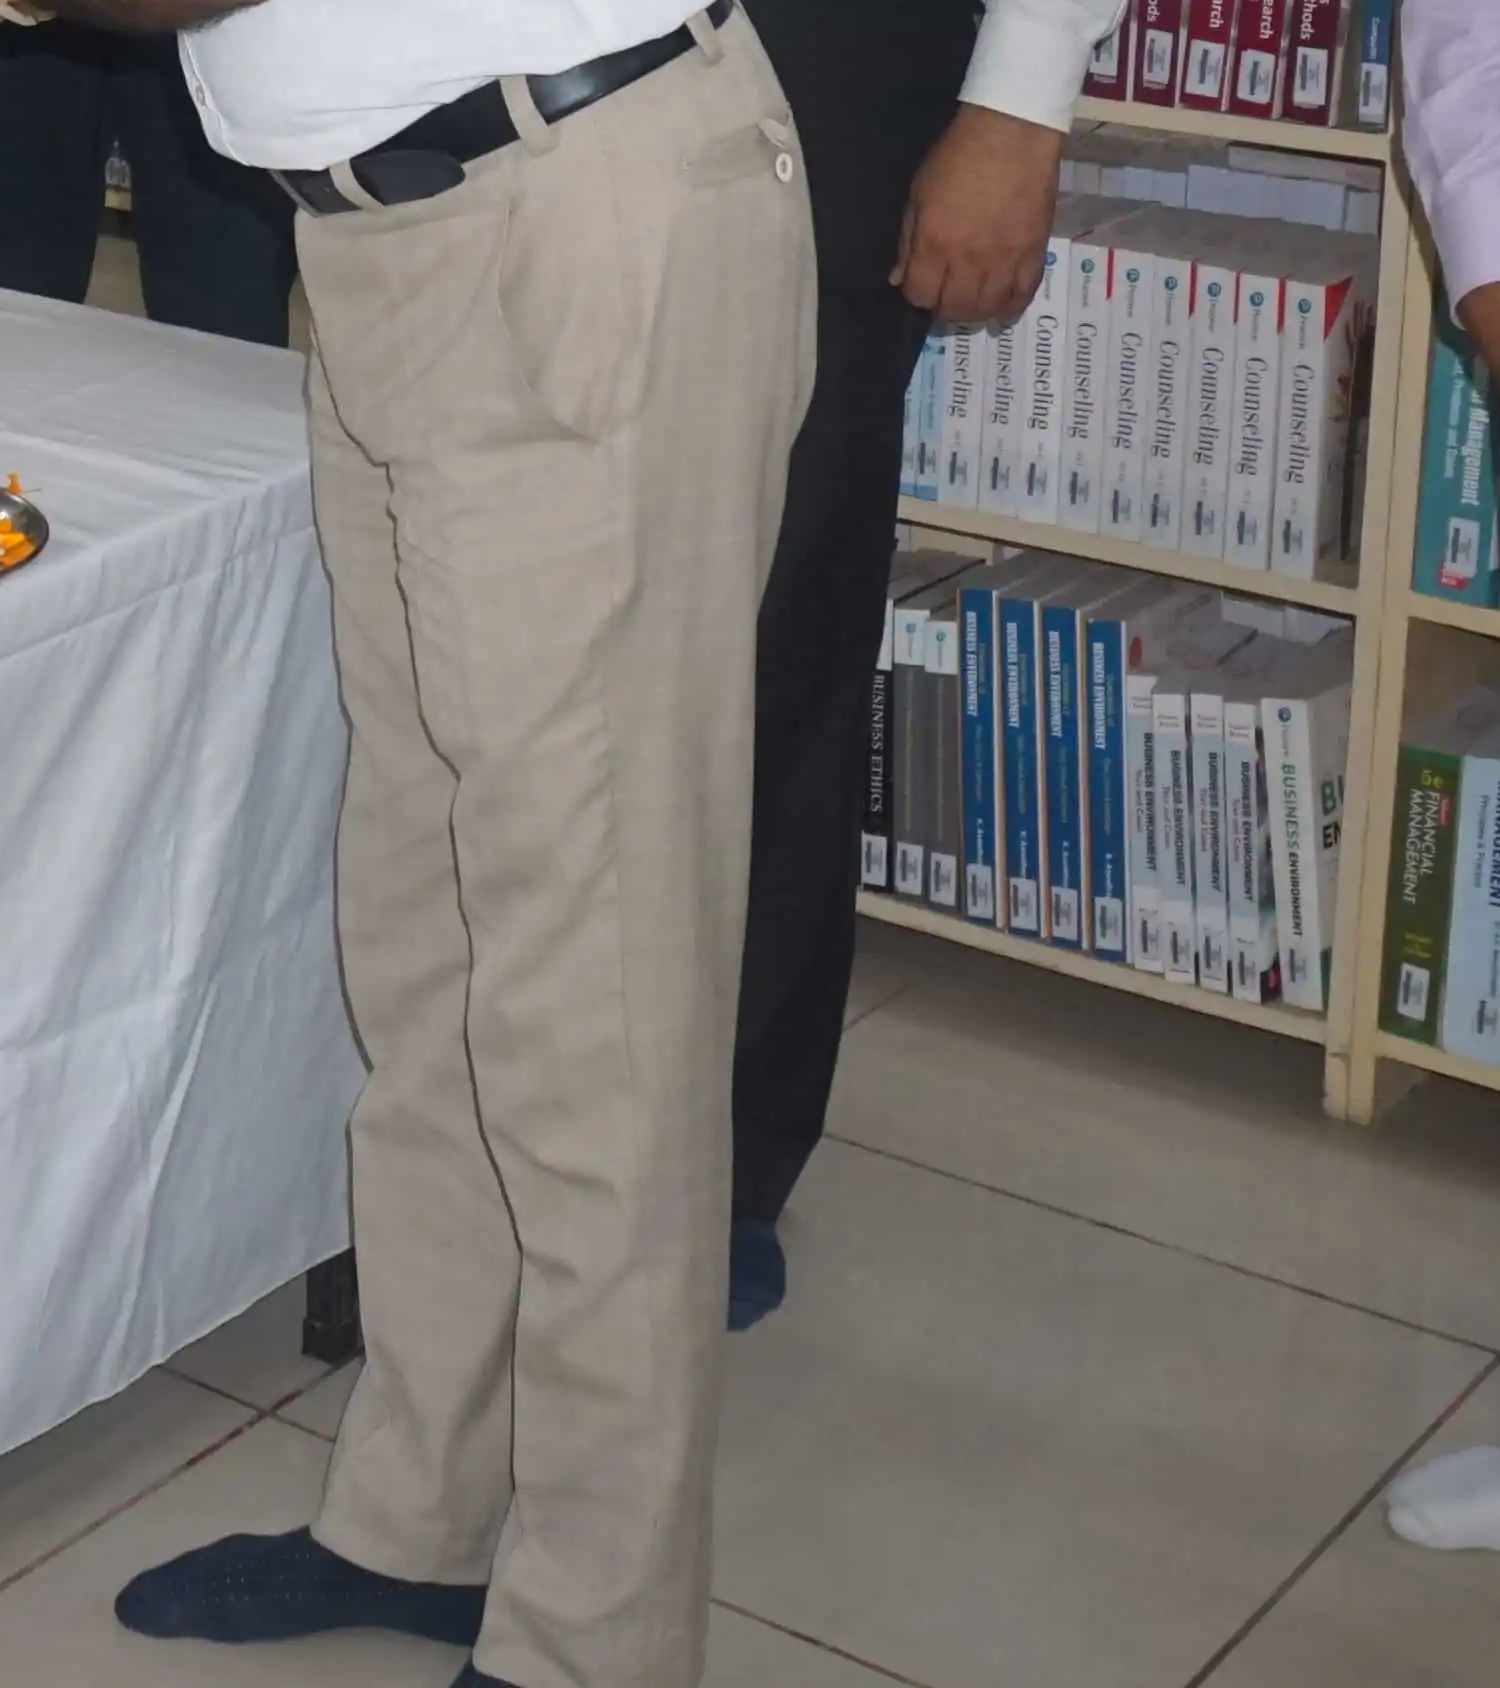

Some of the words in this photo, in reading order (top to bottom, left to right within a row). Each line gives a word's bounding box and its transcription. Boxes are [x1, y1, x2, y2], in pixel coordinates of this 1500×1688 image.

[1027, 315, 1059, 430] Counseling
[1069, 322, 1098, 440] Counseling
[1111, 332, 1143, 450] Counseling
[1151, 340, 1181, 459] Counseling
[1193, 347, 1225, 466] Counseling
[1237, 357, 1268, 476] Counseling
[1285, 364, 1316, 484] Counseling
[1461, 407, 1490, 506] Management
[871, 674, 885, 751] BUSINESS
[870, 754, 883, 814] ETHICS
[1281, 764, 1300, 850] BUSINESS
[1420, 790, 1441, 875] FINANCIAL
[1403, 788, 1426, 905] MANAGEMENT
